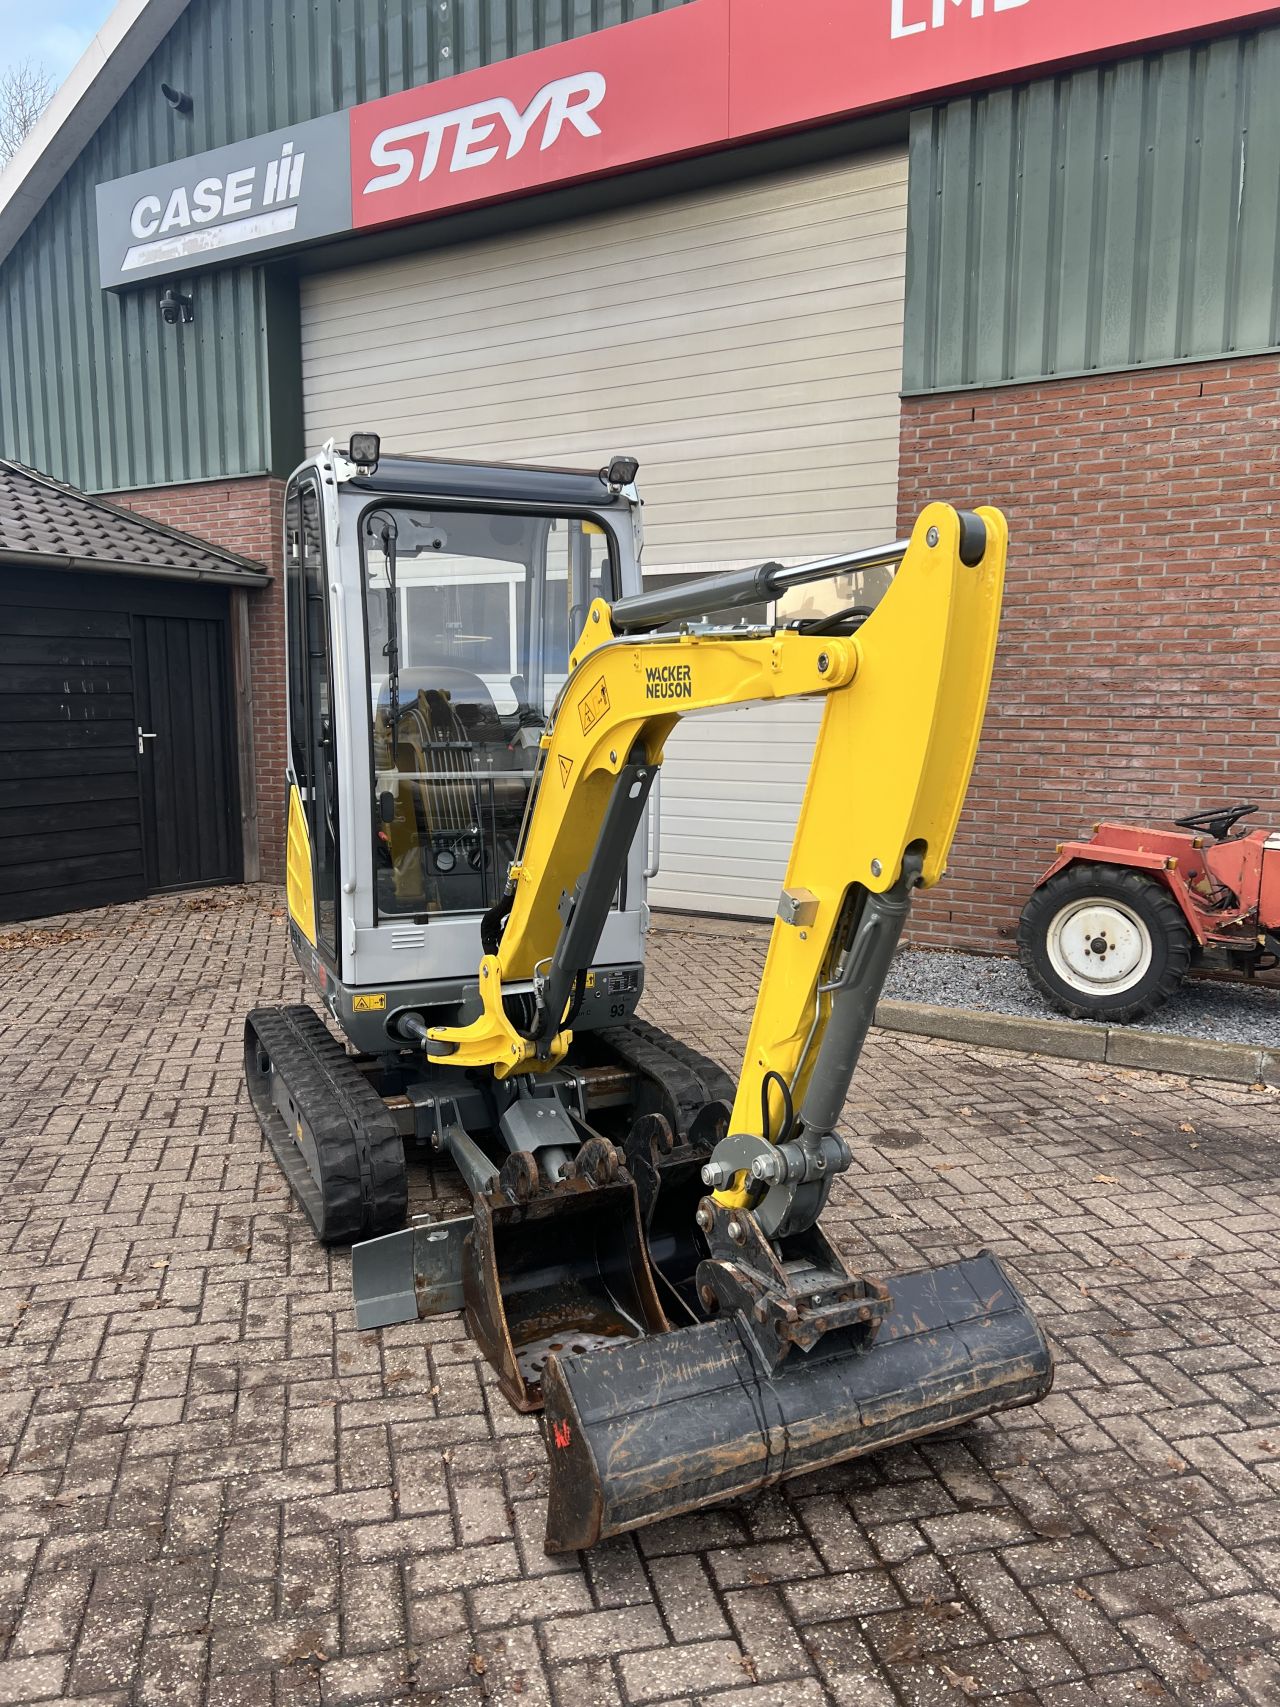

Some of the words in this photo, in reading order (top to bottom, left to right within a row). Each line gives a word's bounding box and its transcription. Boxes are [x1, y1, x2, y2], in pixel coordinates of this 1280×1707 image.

[362, 71, 606, 194] STEYR
[130, 166, 256, 239] CASE
[645, 665, 691, 682] WACKER
[646, 682, 692, 698] NEUSON
[609, 1004, 625, 1017] 93
